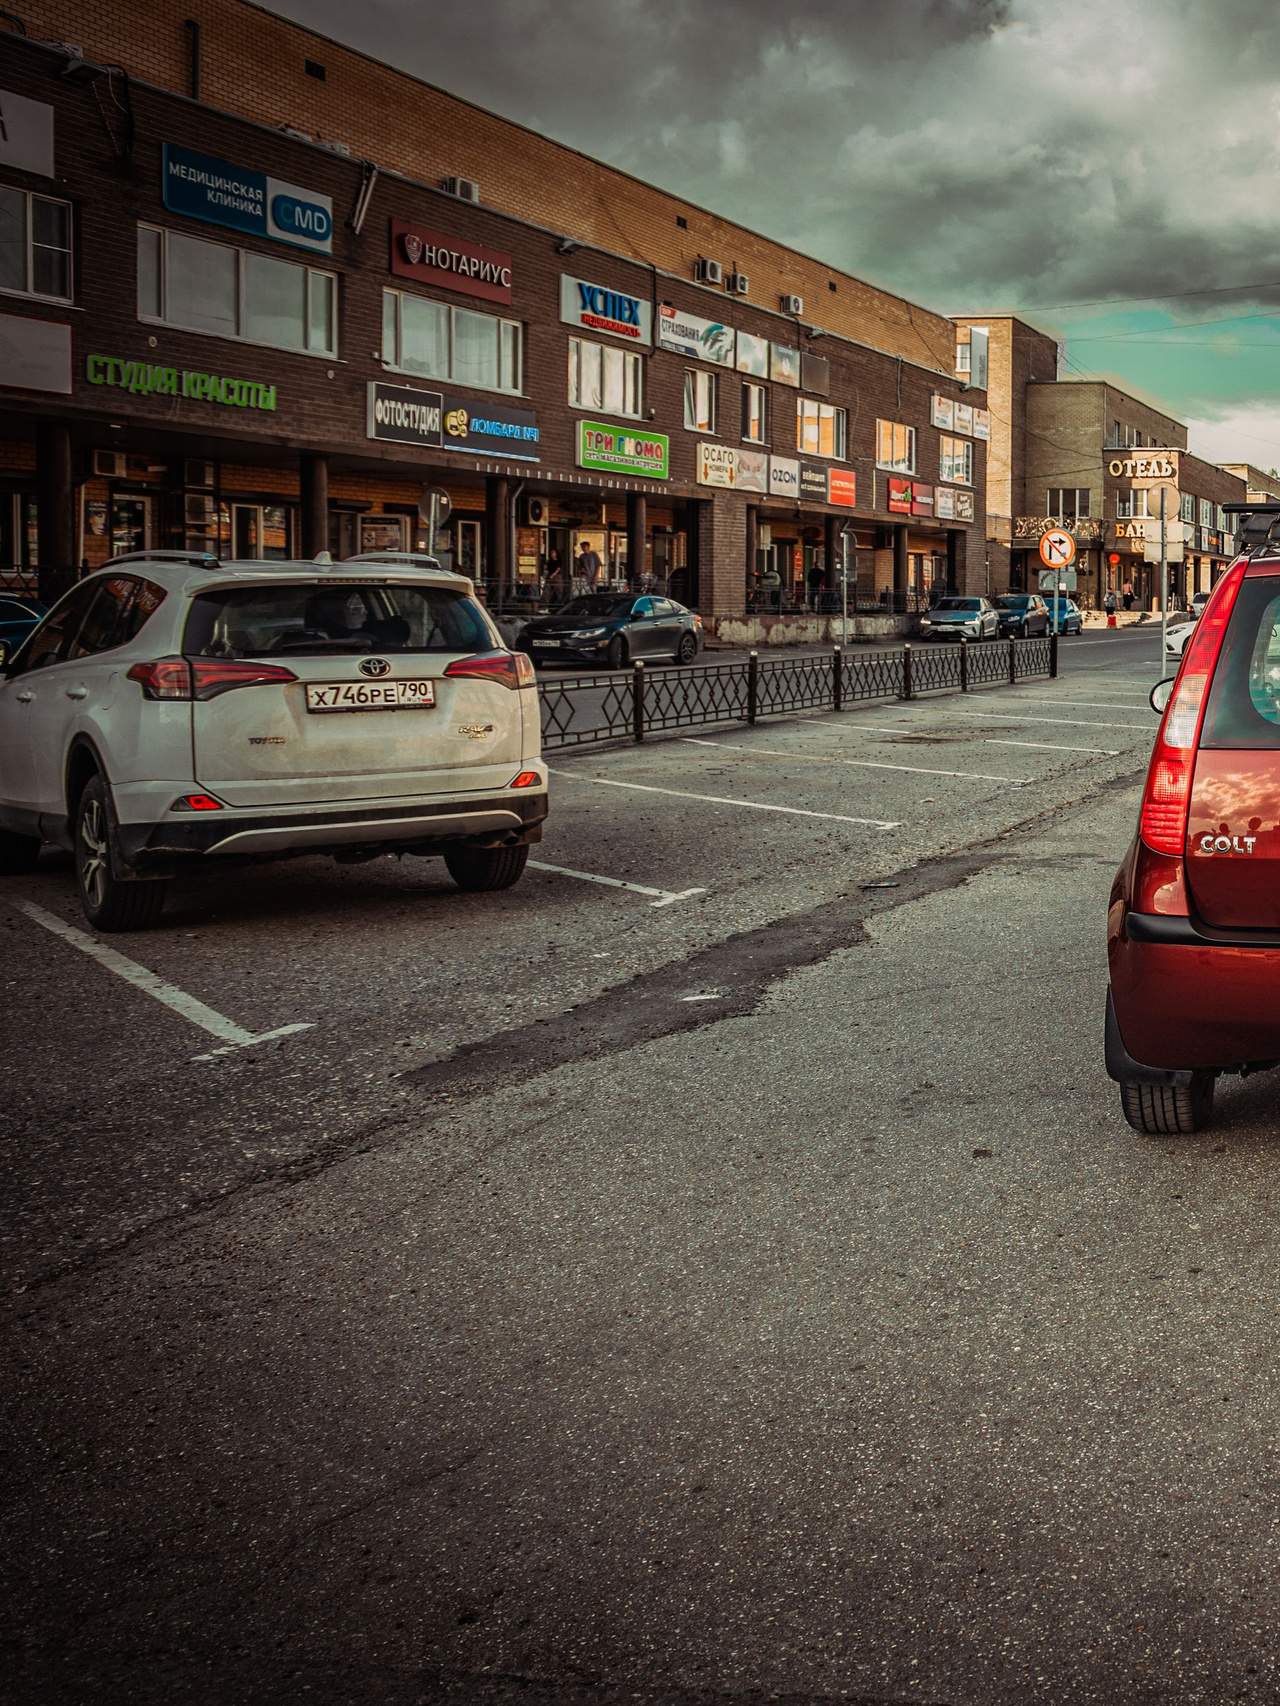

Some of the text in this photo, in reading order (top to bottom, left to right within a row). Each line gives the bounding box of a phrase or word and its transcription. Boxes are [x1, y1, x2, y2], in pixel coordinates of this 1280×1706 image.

[168, 161, 263, 202] МЕДИЦИНСКАЯ
[206, 188, 263, 217] КЛИНИКА
[280, 202, 327, 234] CMD
[425, 243, 511, 288] НОТАРИУС
[577, 282, 640, 325] УСПЕХ
[580, 312, 641, 338] НЕДВИЖИМОСТЬ
[661, 318, 700, 342] СТРАХОВАНИЯ
[87, 354, 178, 396] СТУДИЯ
[181, 370, 277, 411] КРАСОТЫ
[375, 398, 440, 435] ФОТОСТУДИЯ
[470, 417, 539, 442] ЛОМБАРД №1
[585, 430, 614, 453] ТРИ
[703, 447, 734, 465] ОСАГО
[1109, 458, 1173, 478] ОТЕЛЬ
[772, 468, 797, 485] OZON
[398, 682, 428, 697] 790
[1200, 835, 1256, 855] COLT
